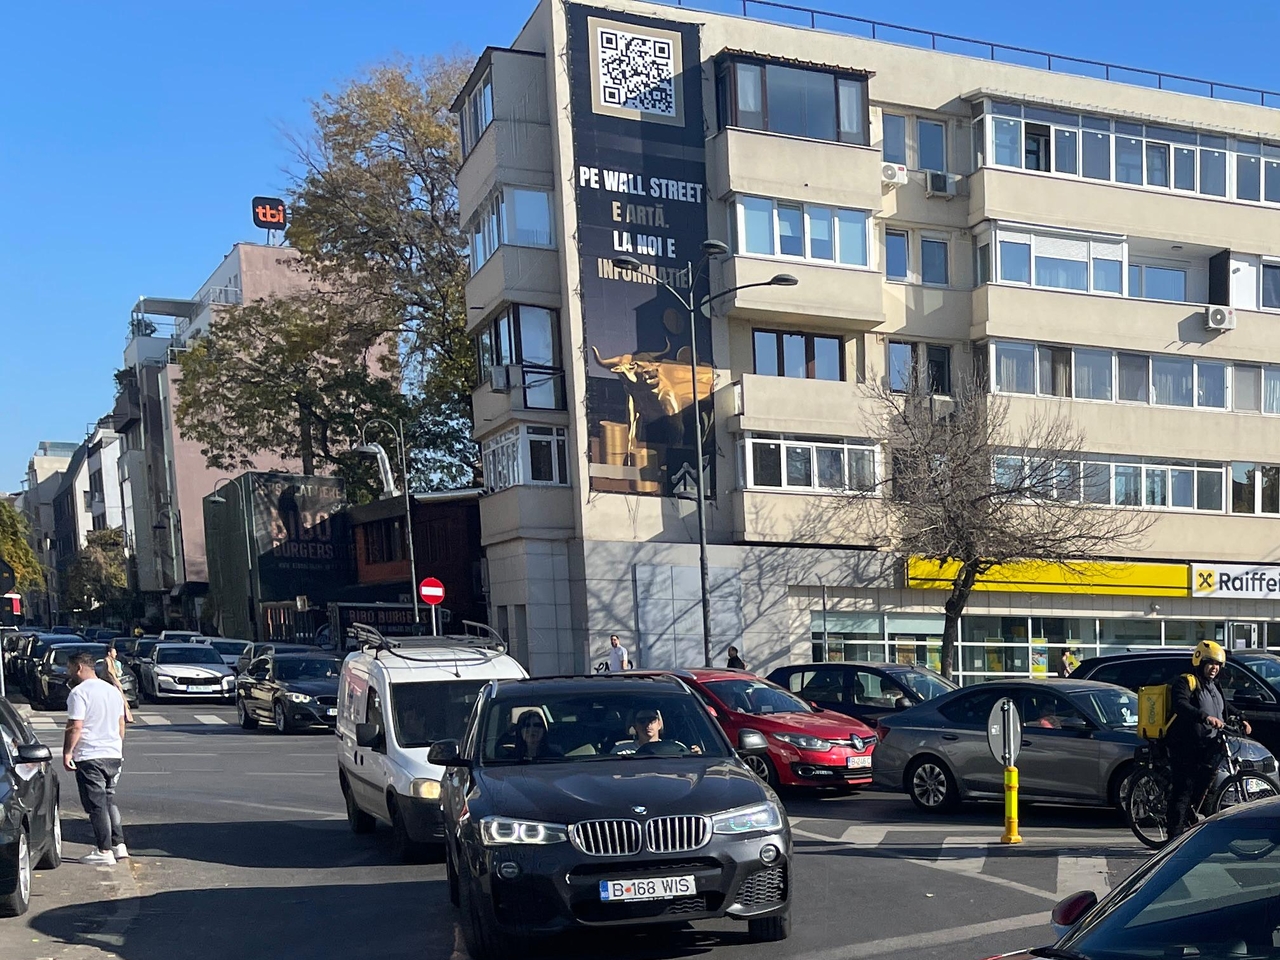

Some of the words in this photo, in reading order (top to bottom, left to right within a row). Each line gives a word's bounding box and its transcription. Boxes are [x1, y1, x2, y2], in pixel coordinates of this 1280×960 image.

[580, 166, 600, 189] PE
[603, 169, 646, 196] WALL
[650, 177, 703, 203] STREET
[256, 204, 284, 223] tbi
[612, 201, 622, 222] E
[626, 203, 670, 228] ARTĂ.
[613, 230, 633, 253] LA
[637, 234, 662, 256] NOI
[667, 238, 676, 258] E
[272, 540, 334, 559] BURGERS
[612, 882, 624, 898] B
[631, 880, 656, 896] 168
[661, 878, 690, 894] WIS
